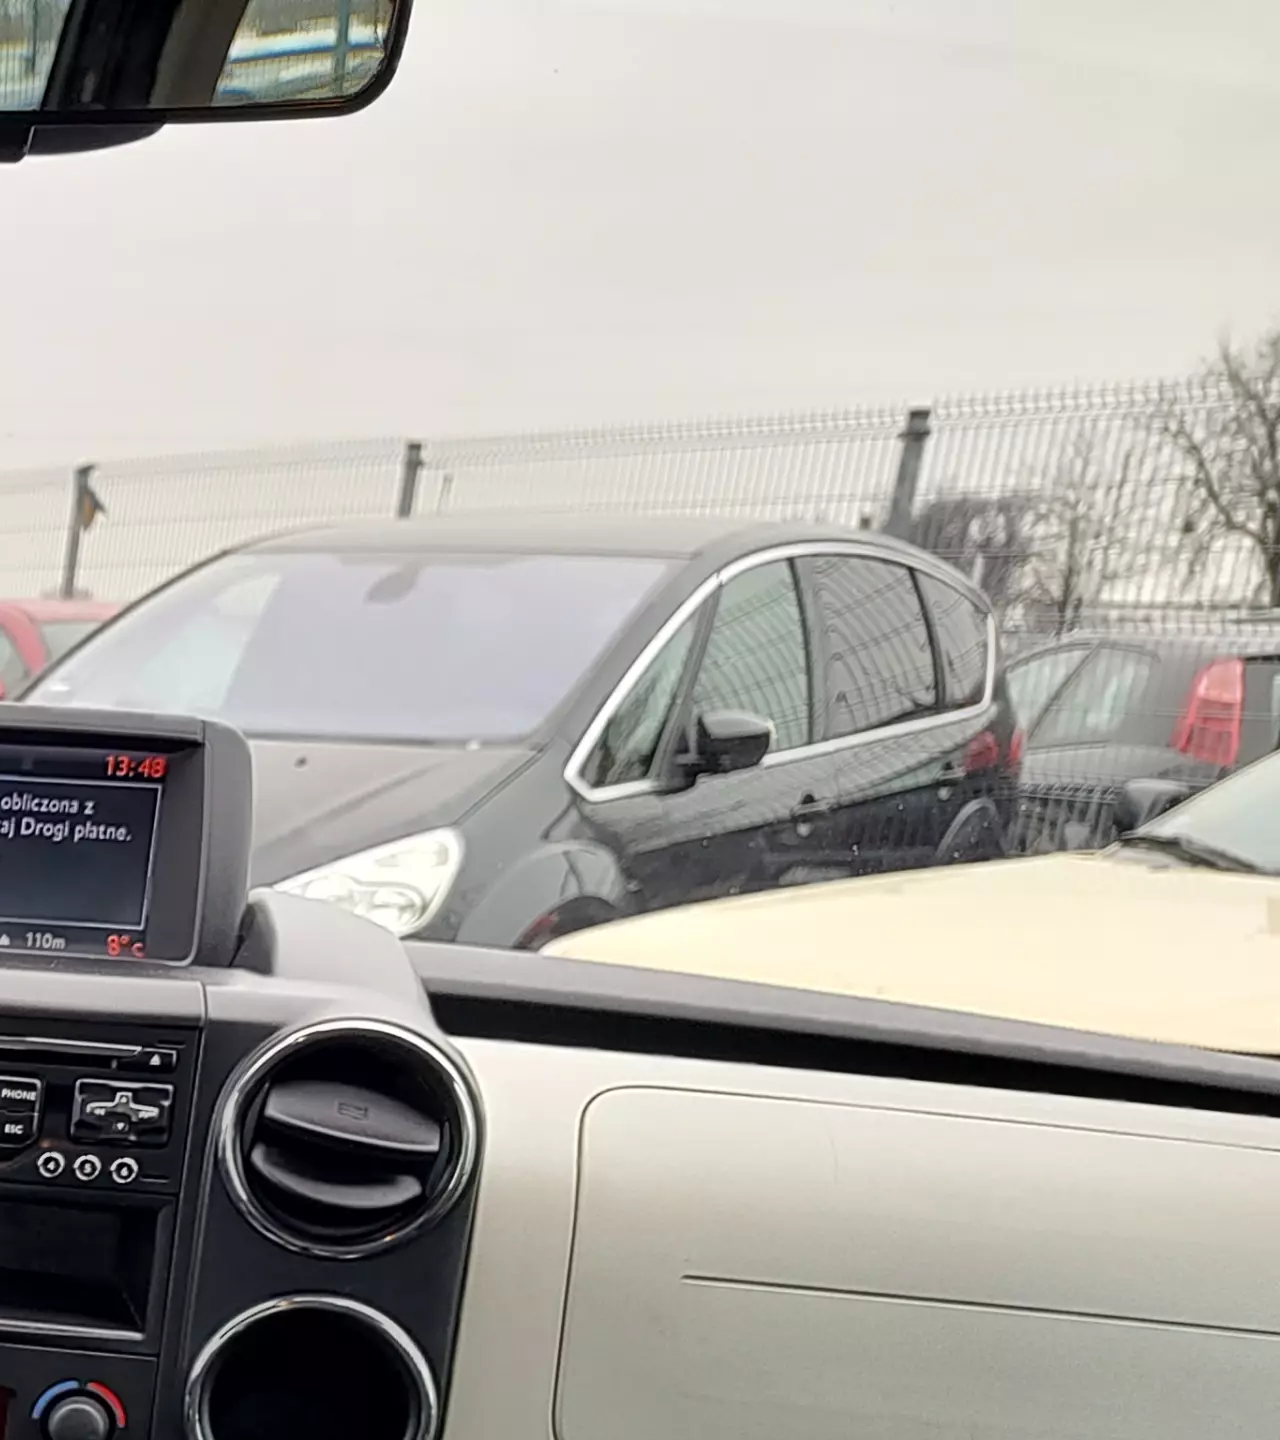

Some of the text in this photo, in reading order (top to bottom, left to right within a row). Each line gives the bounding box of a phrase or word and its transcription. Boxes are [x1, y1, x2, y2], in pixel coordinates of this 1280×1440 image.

[105, 754, 168, 778] 13:48
[0, 792, 80, 815] obliczona
[83, 799, 96, 816] z
[20, 816, 71, 842] Drogi
[25, 931, 67, 951] 110m
[1, 1086, 37, 1101] PHONE
[4, 1122, 24, 1136] ESC
